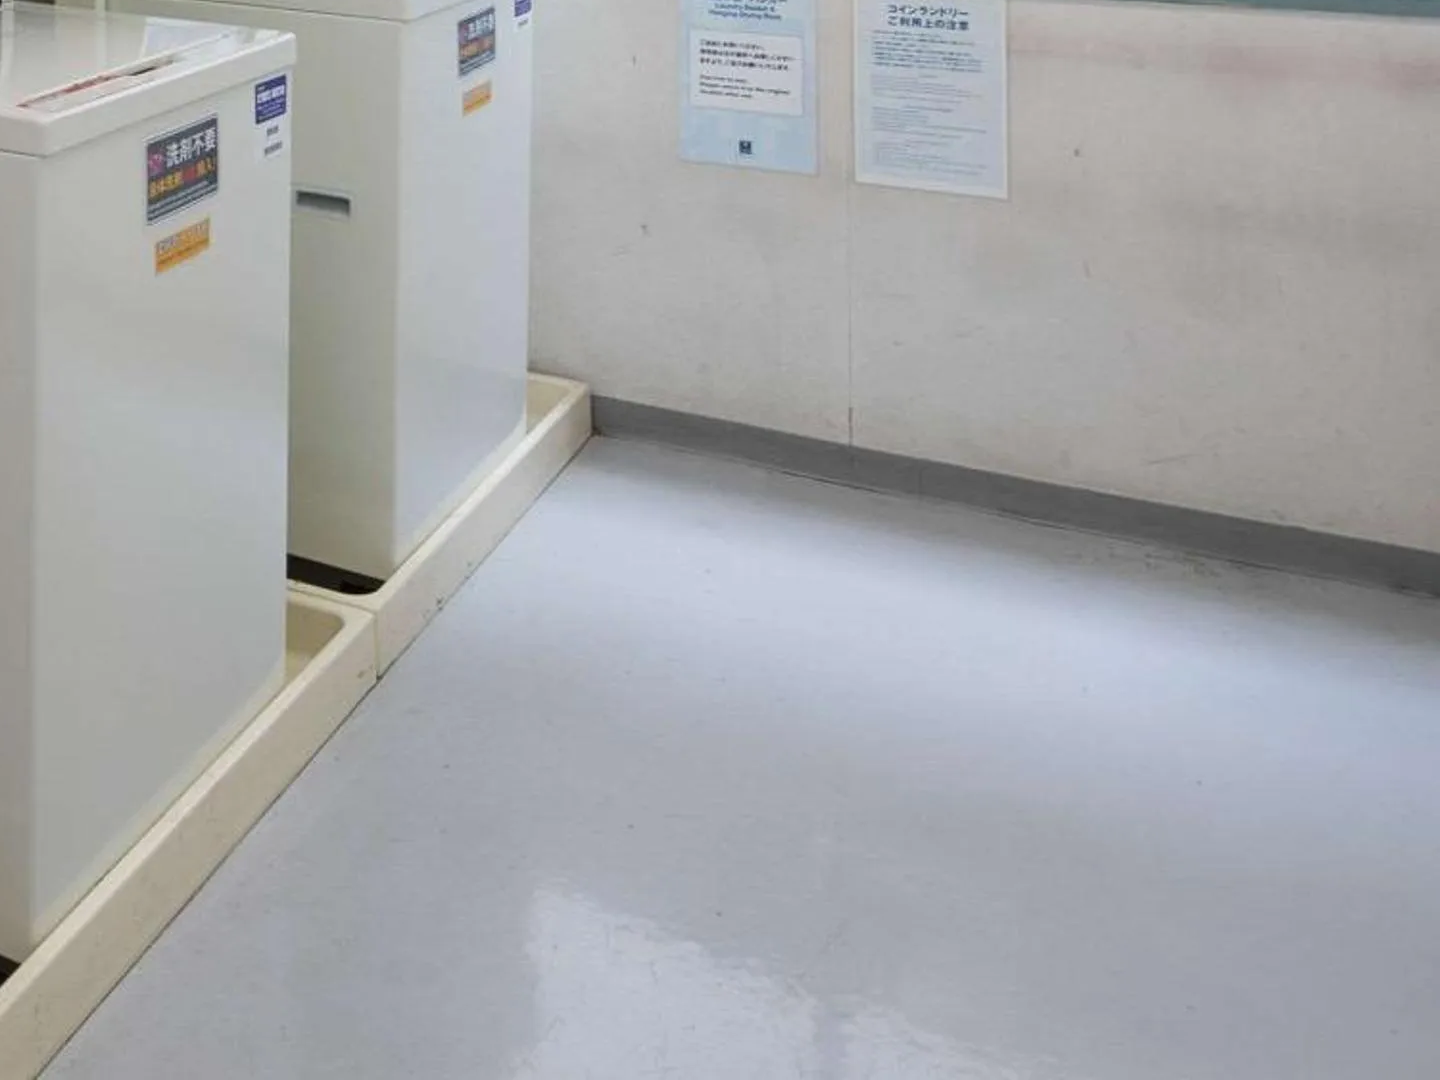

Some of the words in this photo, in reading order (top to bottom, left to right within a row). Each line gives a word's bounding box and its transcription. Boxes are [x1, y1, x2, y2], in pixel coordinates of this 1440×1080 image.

[887, 4, 968, 18] コインランドリー
